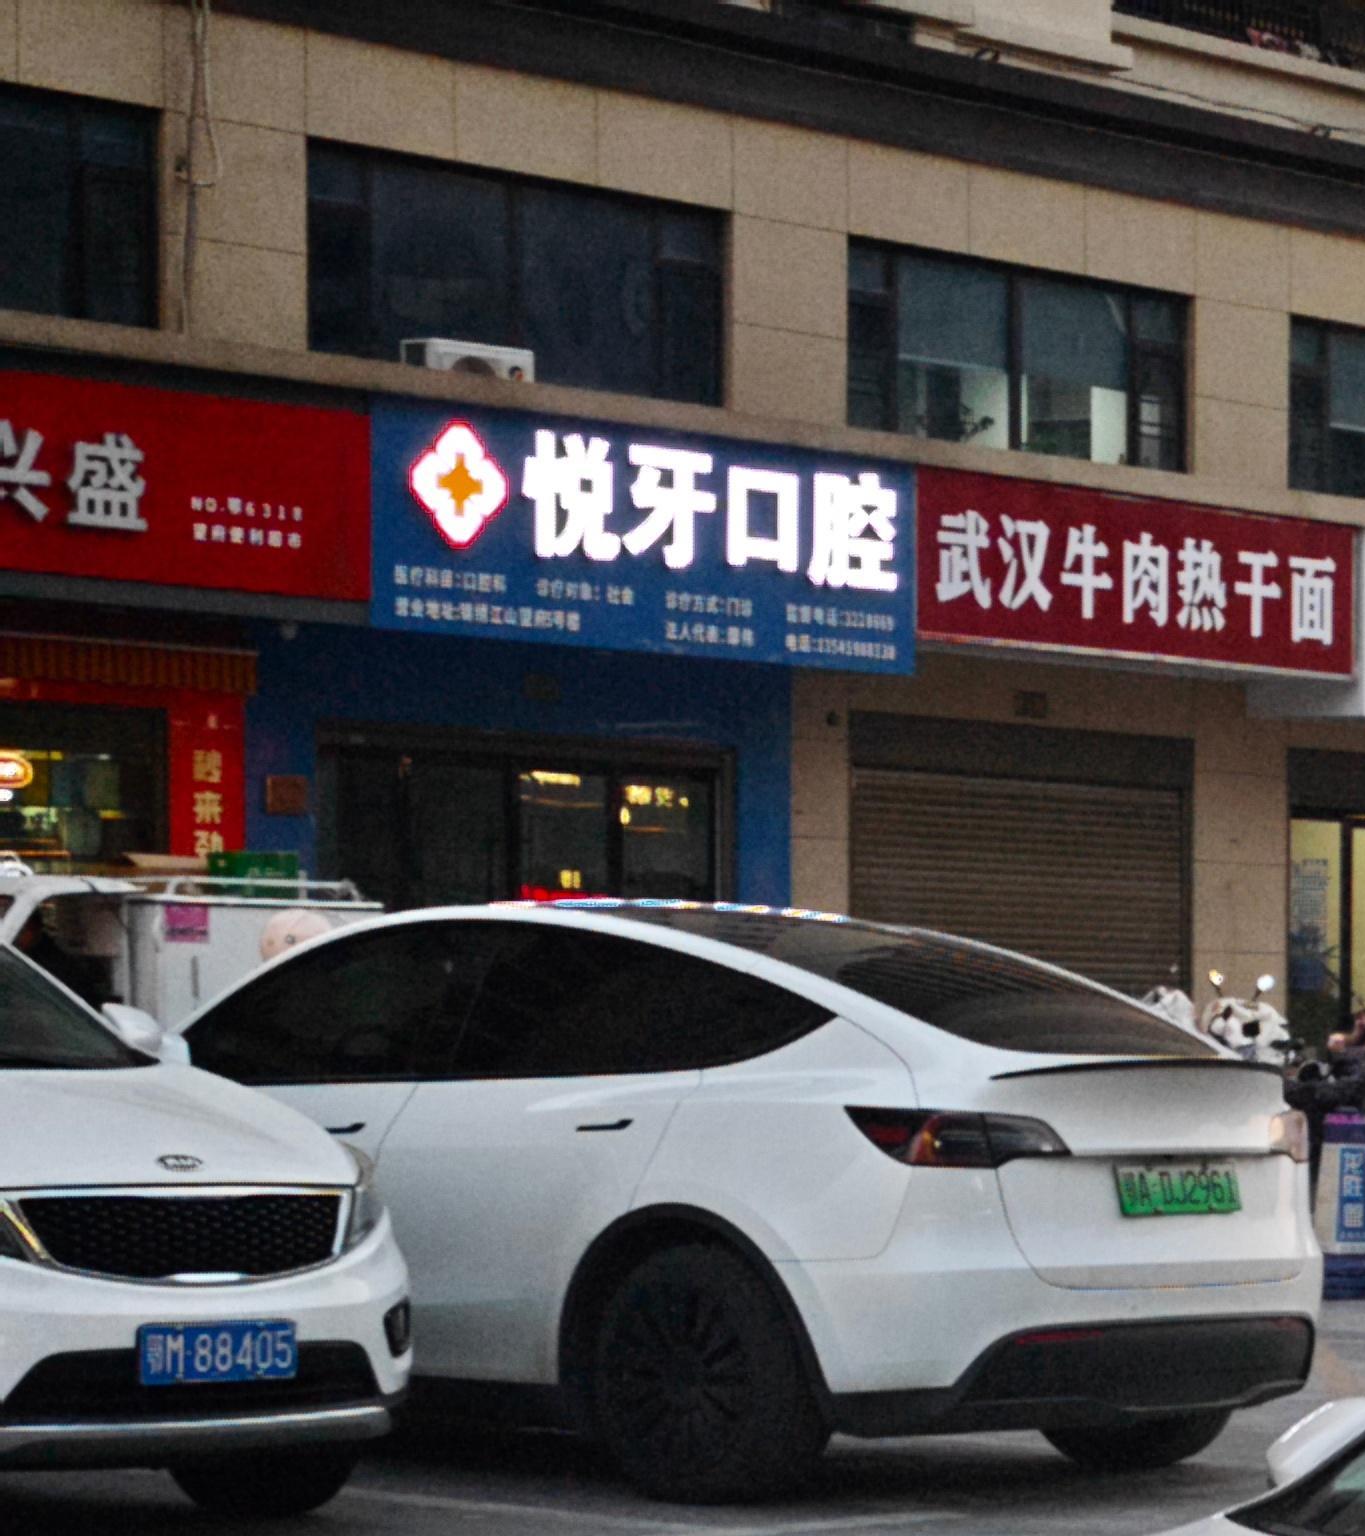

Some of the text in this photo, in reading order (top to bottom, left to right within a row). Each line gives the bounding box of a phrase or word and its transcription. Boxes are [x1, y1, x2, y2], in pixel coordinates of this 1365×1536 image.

[522, 430, 898, 591] 悦牙口腔
[935, 510, 1336, 645] 武汉牛肉热干面
